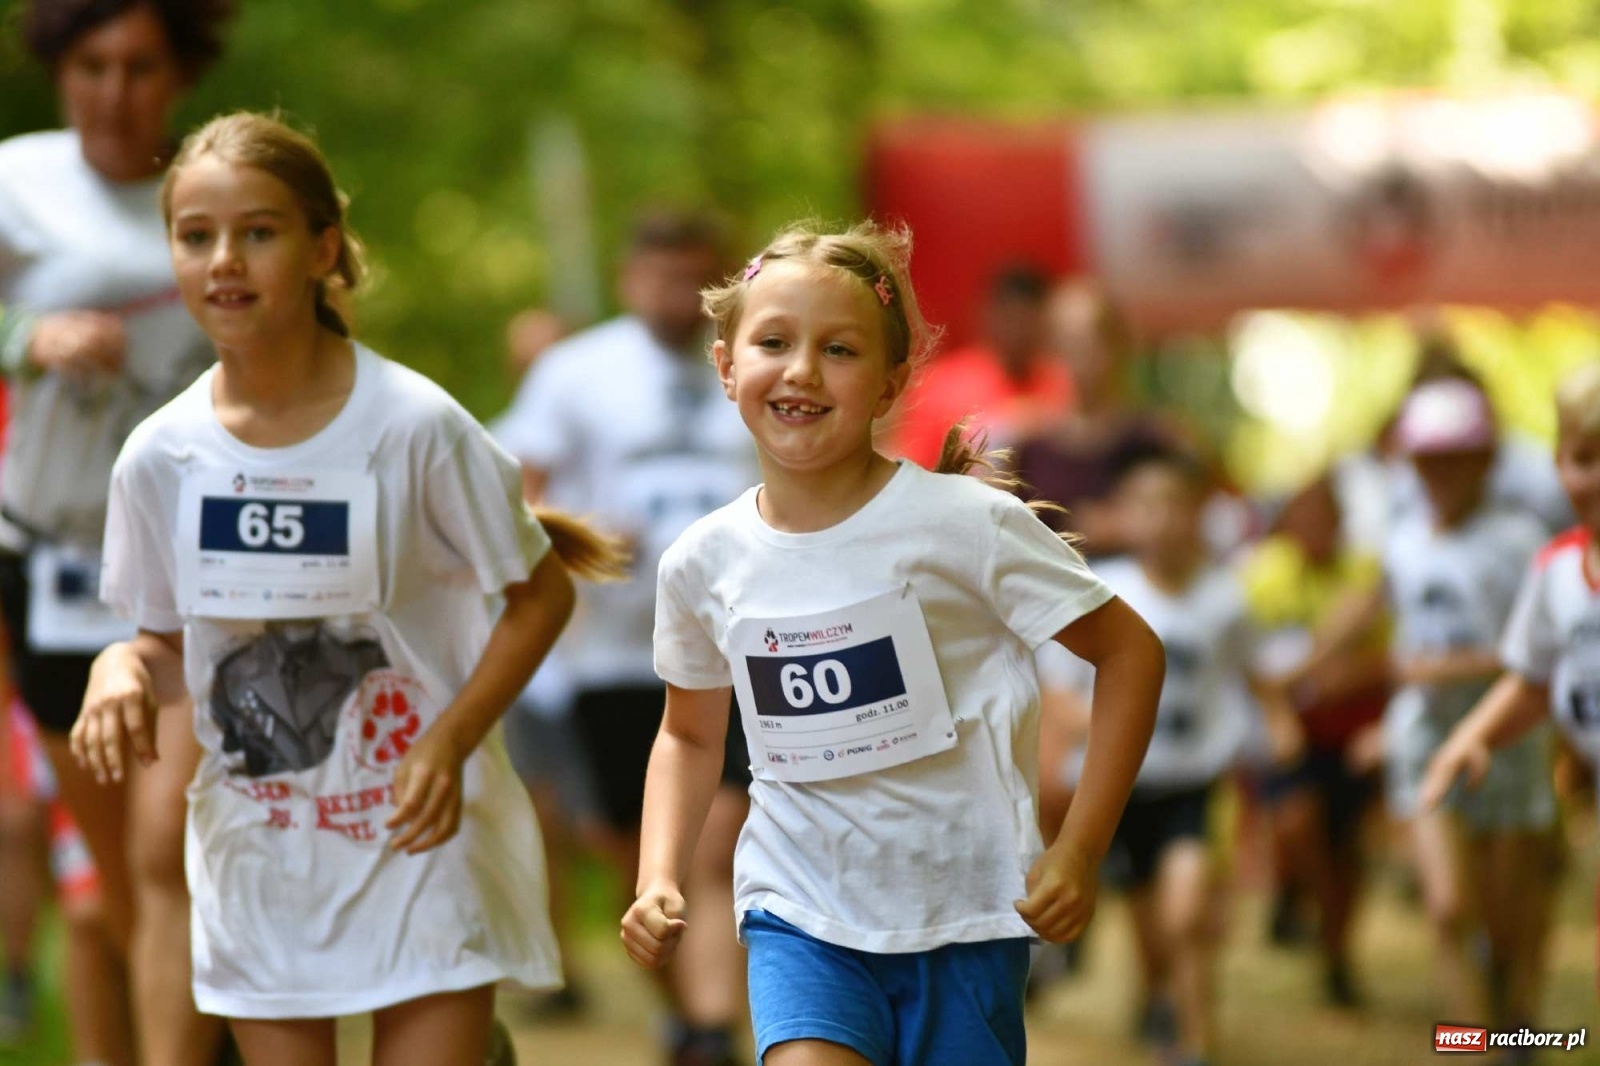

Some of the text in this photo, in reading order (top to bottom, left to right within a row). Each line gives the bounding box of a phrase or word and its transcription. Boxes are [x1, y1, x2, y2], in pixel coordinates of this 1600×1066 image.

[238, 503, 305, 548] 65
[779, 622, 853, 643] TROPEMWILCZYM
[780, 659, 852, 709] 60
[855, 699, 910, 723] godz. 11.00
